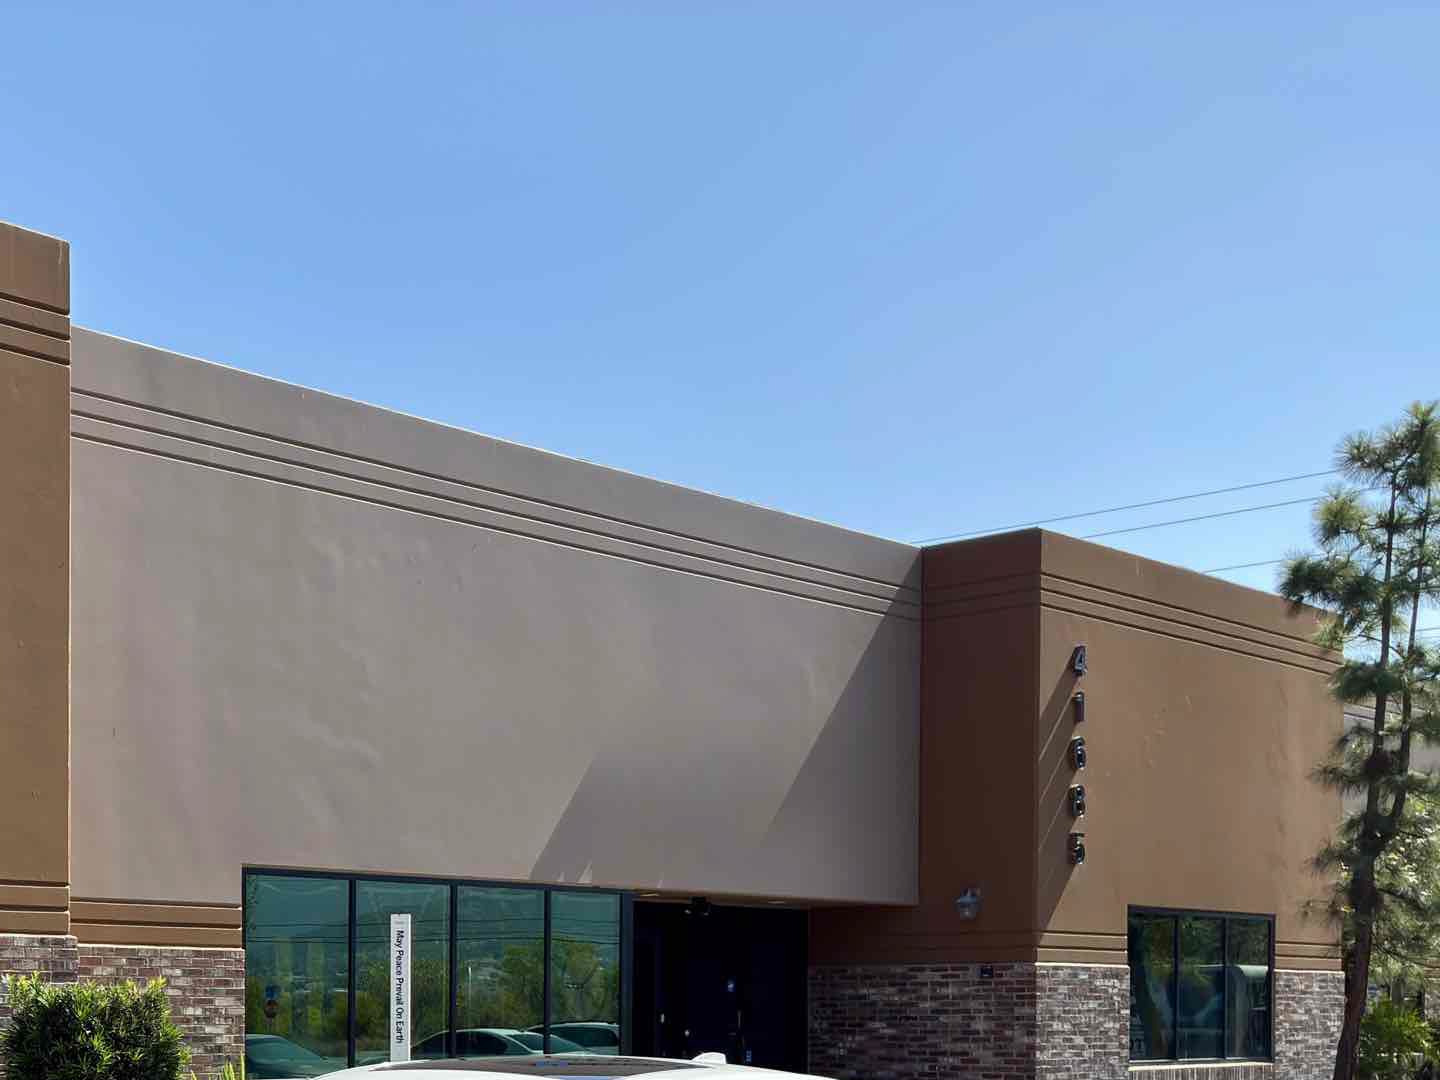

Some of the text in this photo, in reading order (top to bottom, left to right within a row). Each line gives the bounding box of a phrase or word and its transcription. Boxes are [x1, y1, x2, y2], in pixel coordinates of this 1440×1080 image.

[394, 929, 405, 949] May
[395, 977, 405, 1006] Prevail
[395, 1007, 405, 1020] On
[395, 1021, 405, 1044] Earth
